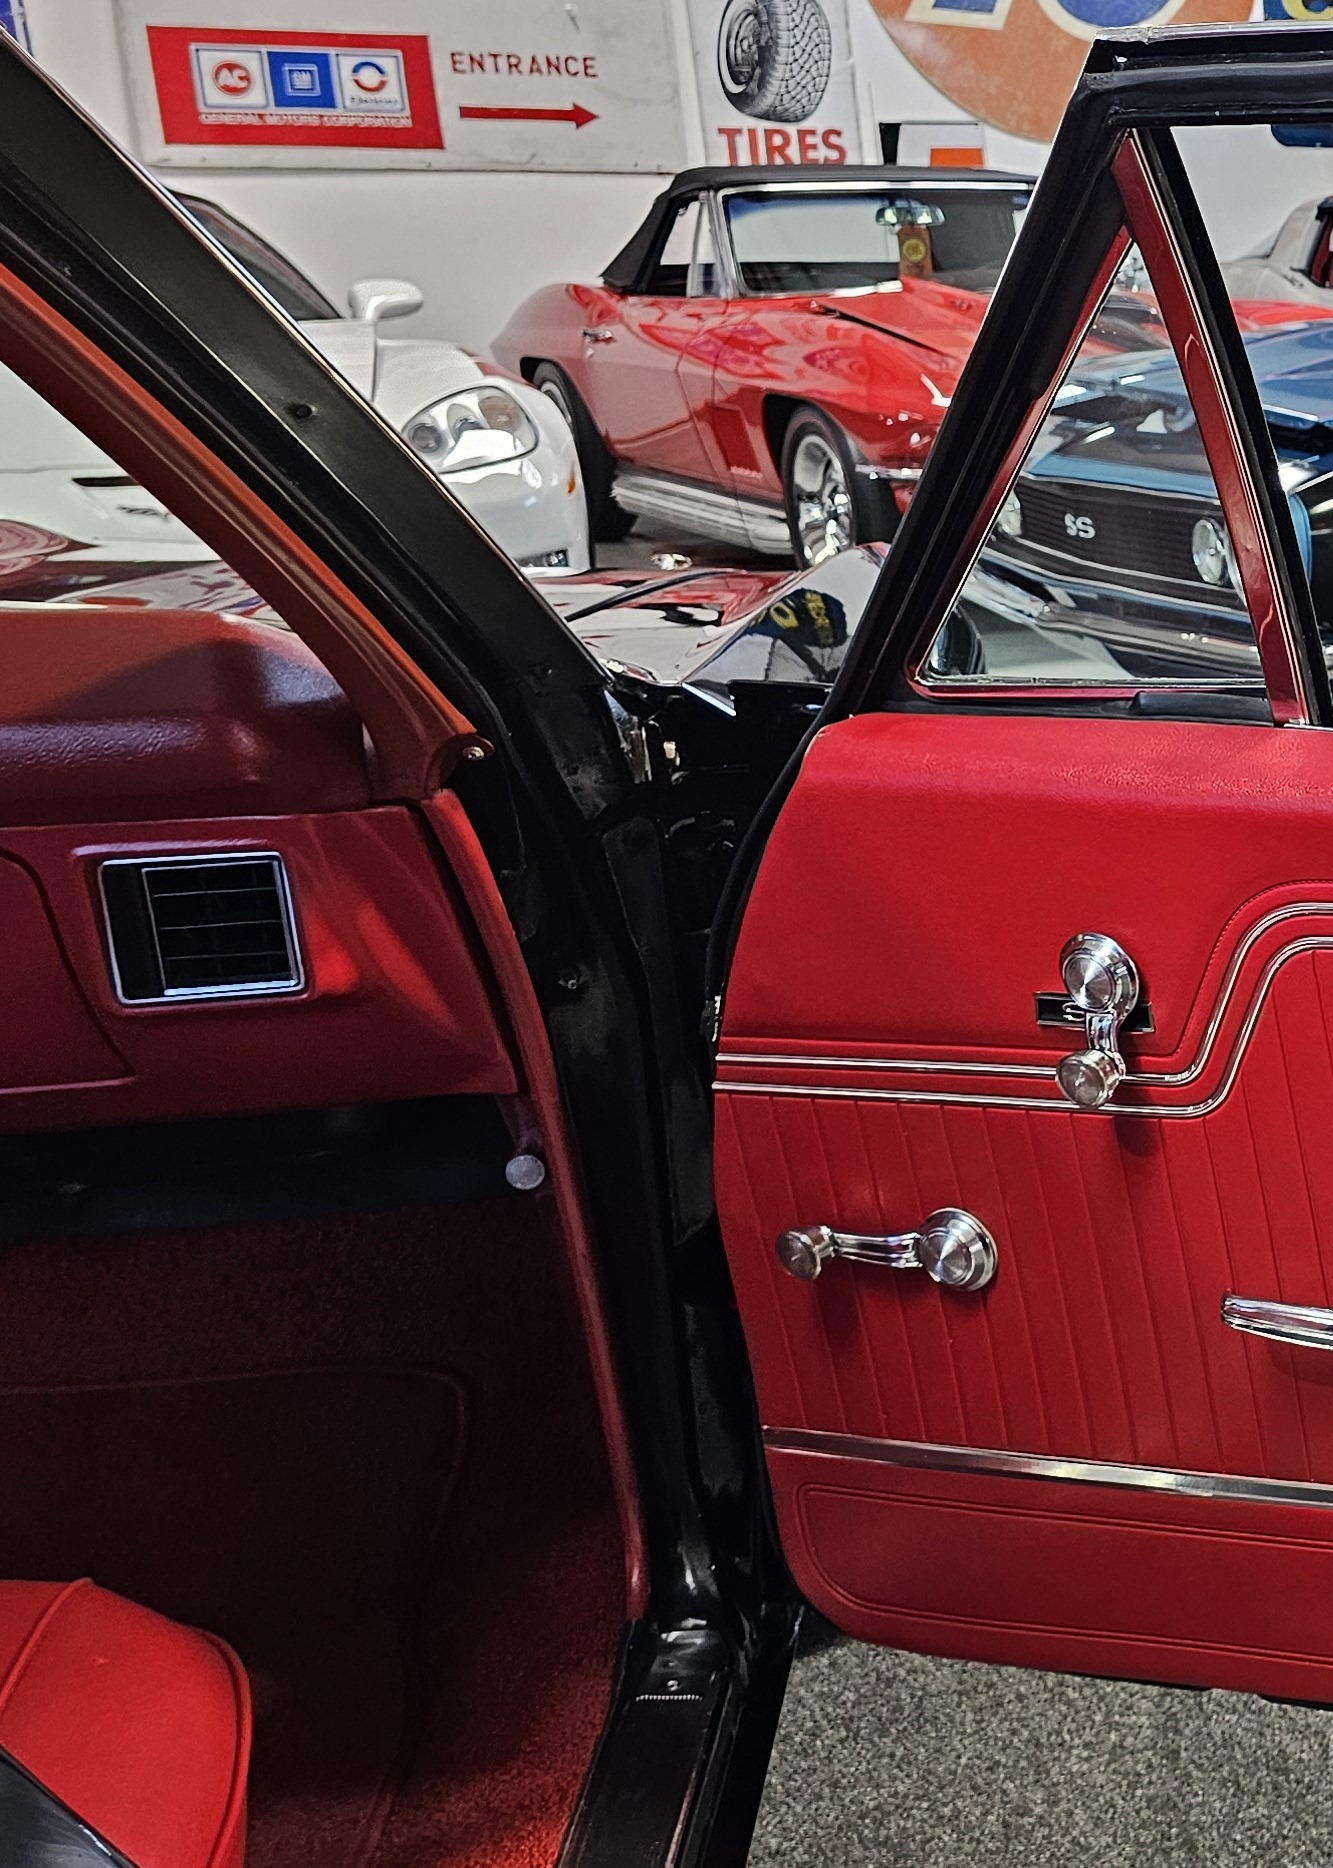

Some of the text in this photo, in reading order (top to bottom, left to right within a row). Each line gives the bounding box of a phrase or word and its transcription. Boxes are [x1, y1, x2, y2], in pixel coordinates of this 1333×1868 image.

[215, 65, 251, 90] AC
[450, 52, 598, 78] ENTRANCE
[200, 112, 412, 128] GENERAL MOTORS CORPORATION
[718, 127, 848, 166] TIRES
[1064, 513, 1096, 539] SS
